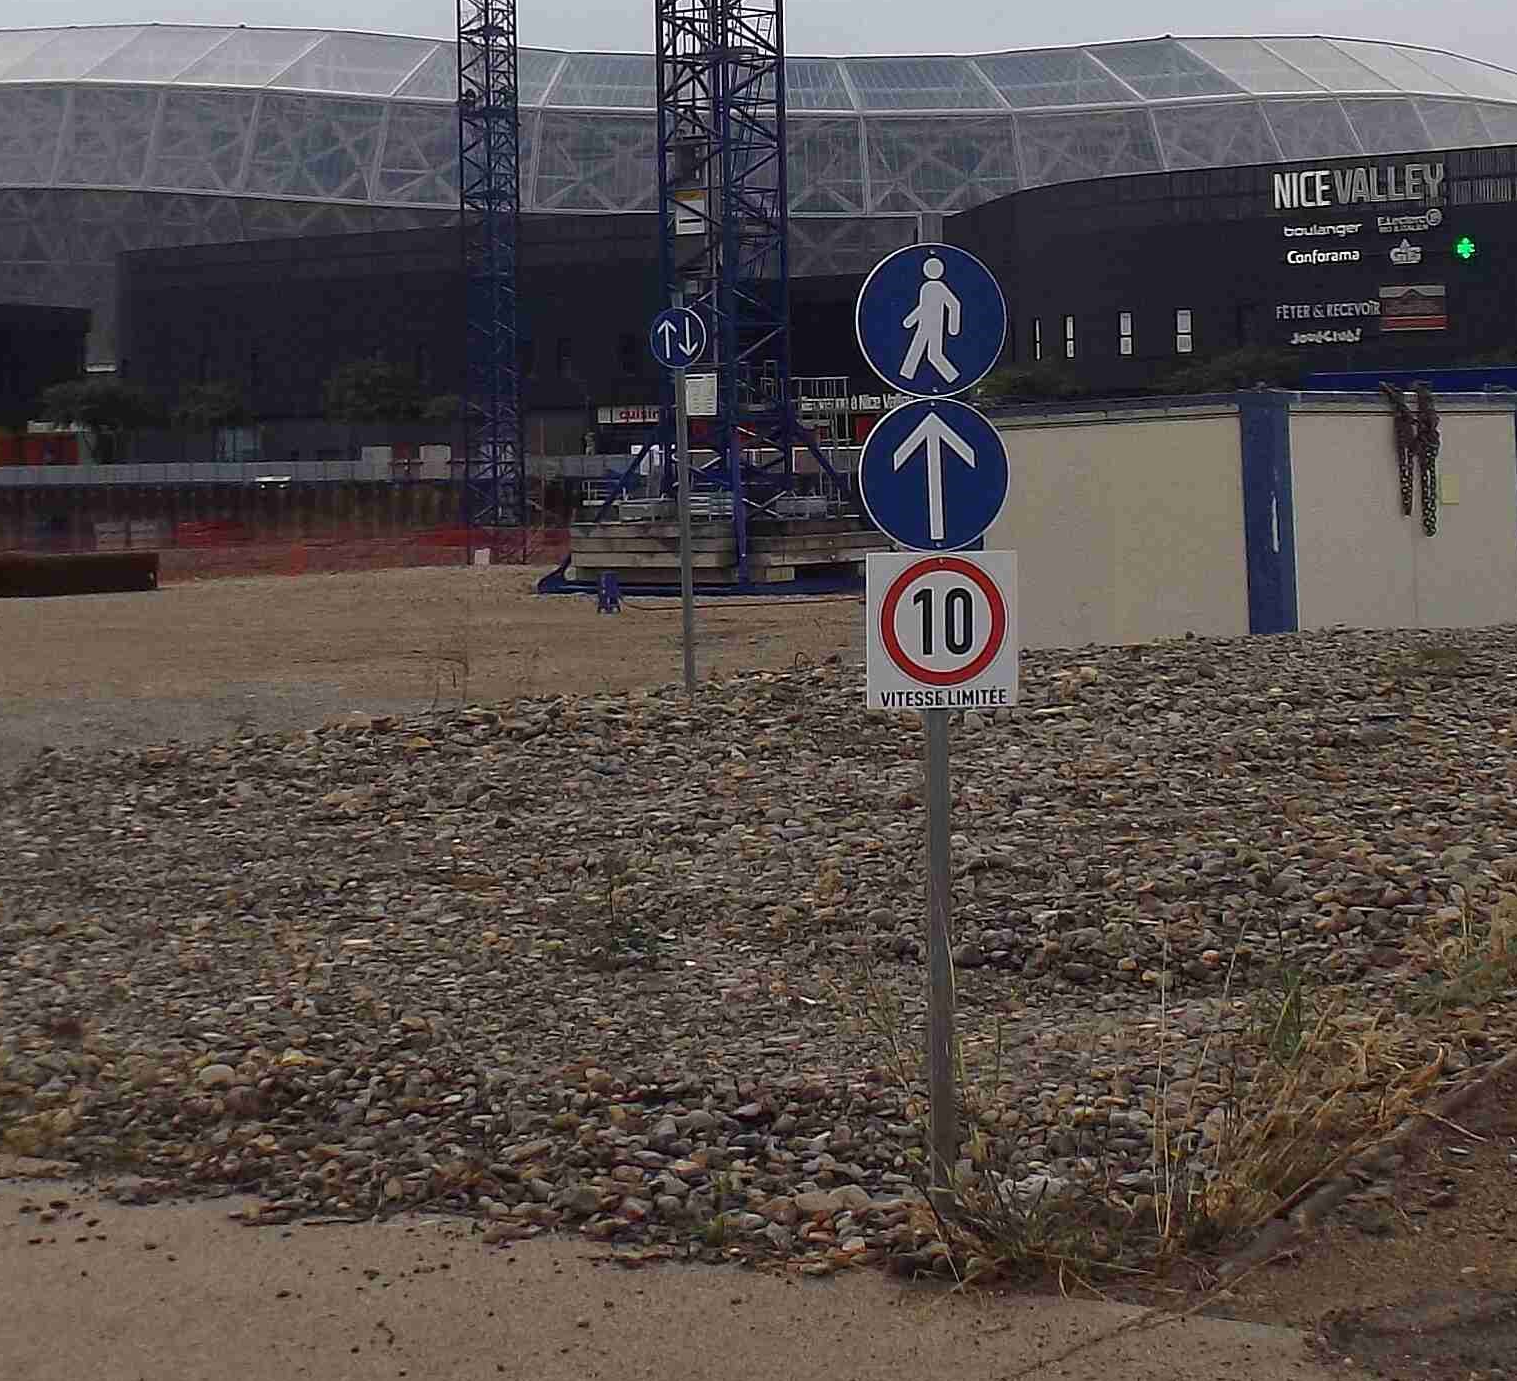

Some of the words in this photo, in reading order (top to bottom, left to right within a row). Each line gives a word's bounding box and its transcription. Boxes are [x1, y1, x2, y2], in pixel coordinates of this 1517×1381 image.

[1274, 170, 1332, 210] NICE
[1333, 163, 1444, 205] VALLEY
[1283, 222, 1363, 238] boulanger
[1286, 249, 1361, 265] Conforama
[913, 587, 973, 656] 10
[881, 691, 943, 707] VITESSE
[947, 685, 1007, 706] LIMITÉE
